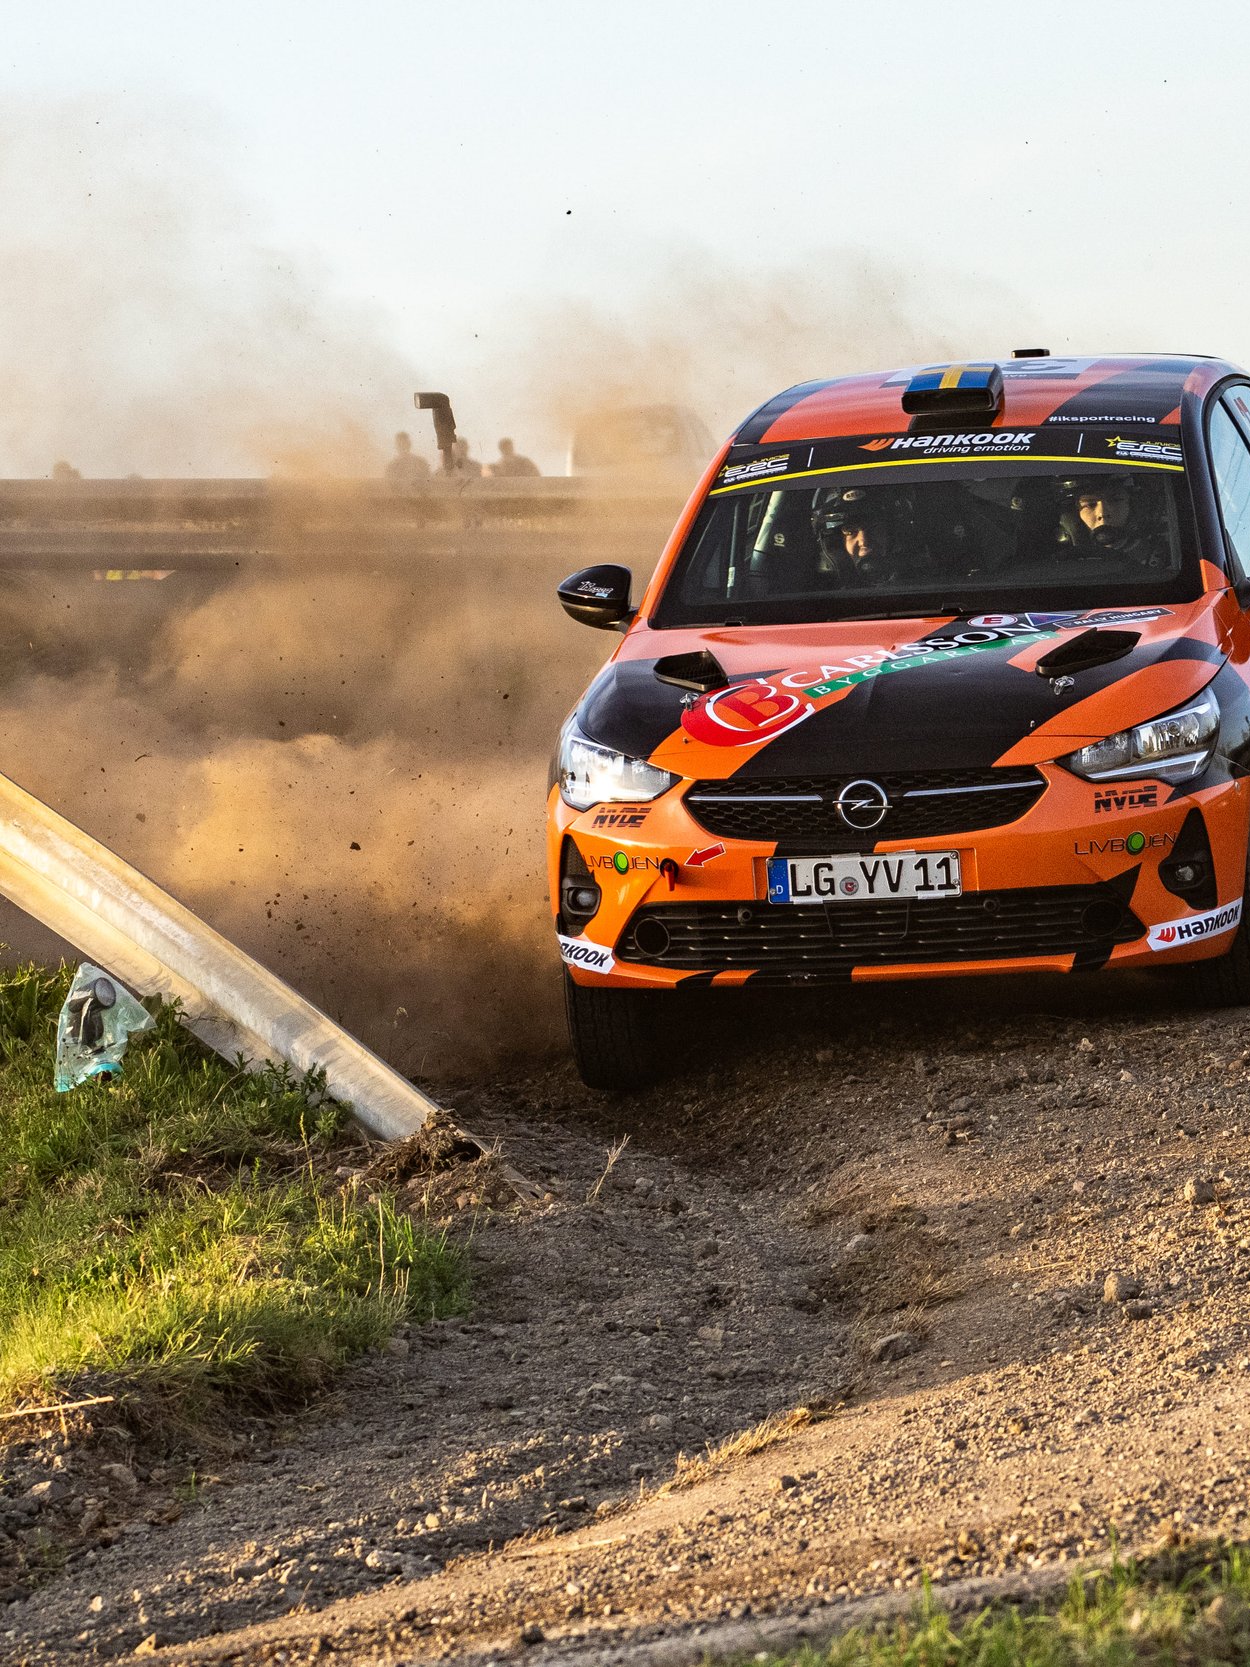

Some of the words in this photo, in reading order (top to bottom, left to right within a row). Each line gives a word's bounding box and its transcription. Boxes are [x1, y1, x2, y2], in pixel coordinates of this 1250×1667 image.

[1048, 415, 1156, 424] #iksportracing
[923, 445, 971, 455] driving
[973, 443, 1030, 452] emotion
[781, 622, 1042, 689] CARLSSON
[812, 645, 985, 696] BYGGARE
[1010, 633, 1052, 646] AB
[788, 862, 836, 897] LG
[859, 859, 904, 894] YV
[913, 856, 958, 892] 11
[775, 885, 784, 895] D
